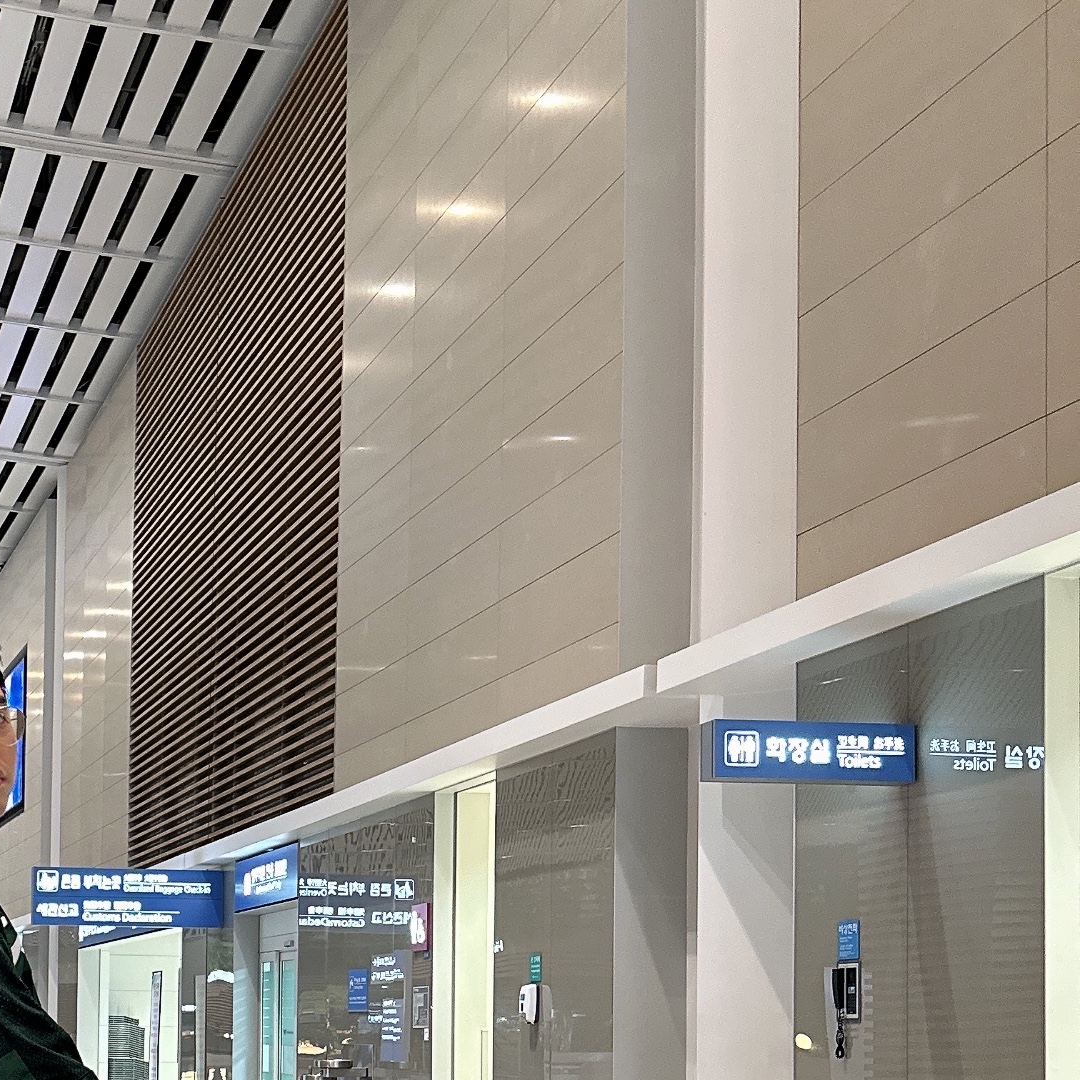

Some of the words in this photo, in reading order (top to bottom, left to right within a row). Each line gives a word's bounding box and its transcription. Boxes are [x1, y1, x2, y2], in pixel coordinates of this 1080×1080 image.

[766, 735, 831, 764] 화장실
[837, 753, 882, 769] Toilets
[82, 912, 121, 922] Customs
[122, 912, 173, 923] Declaration
